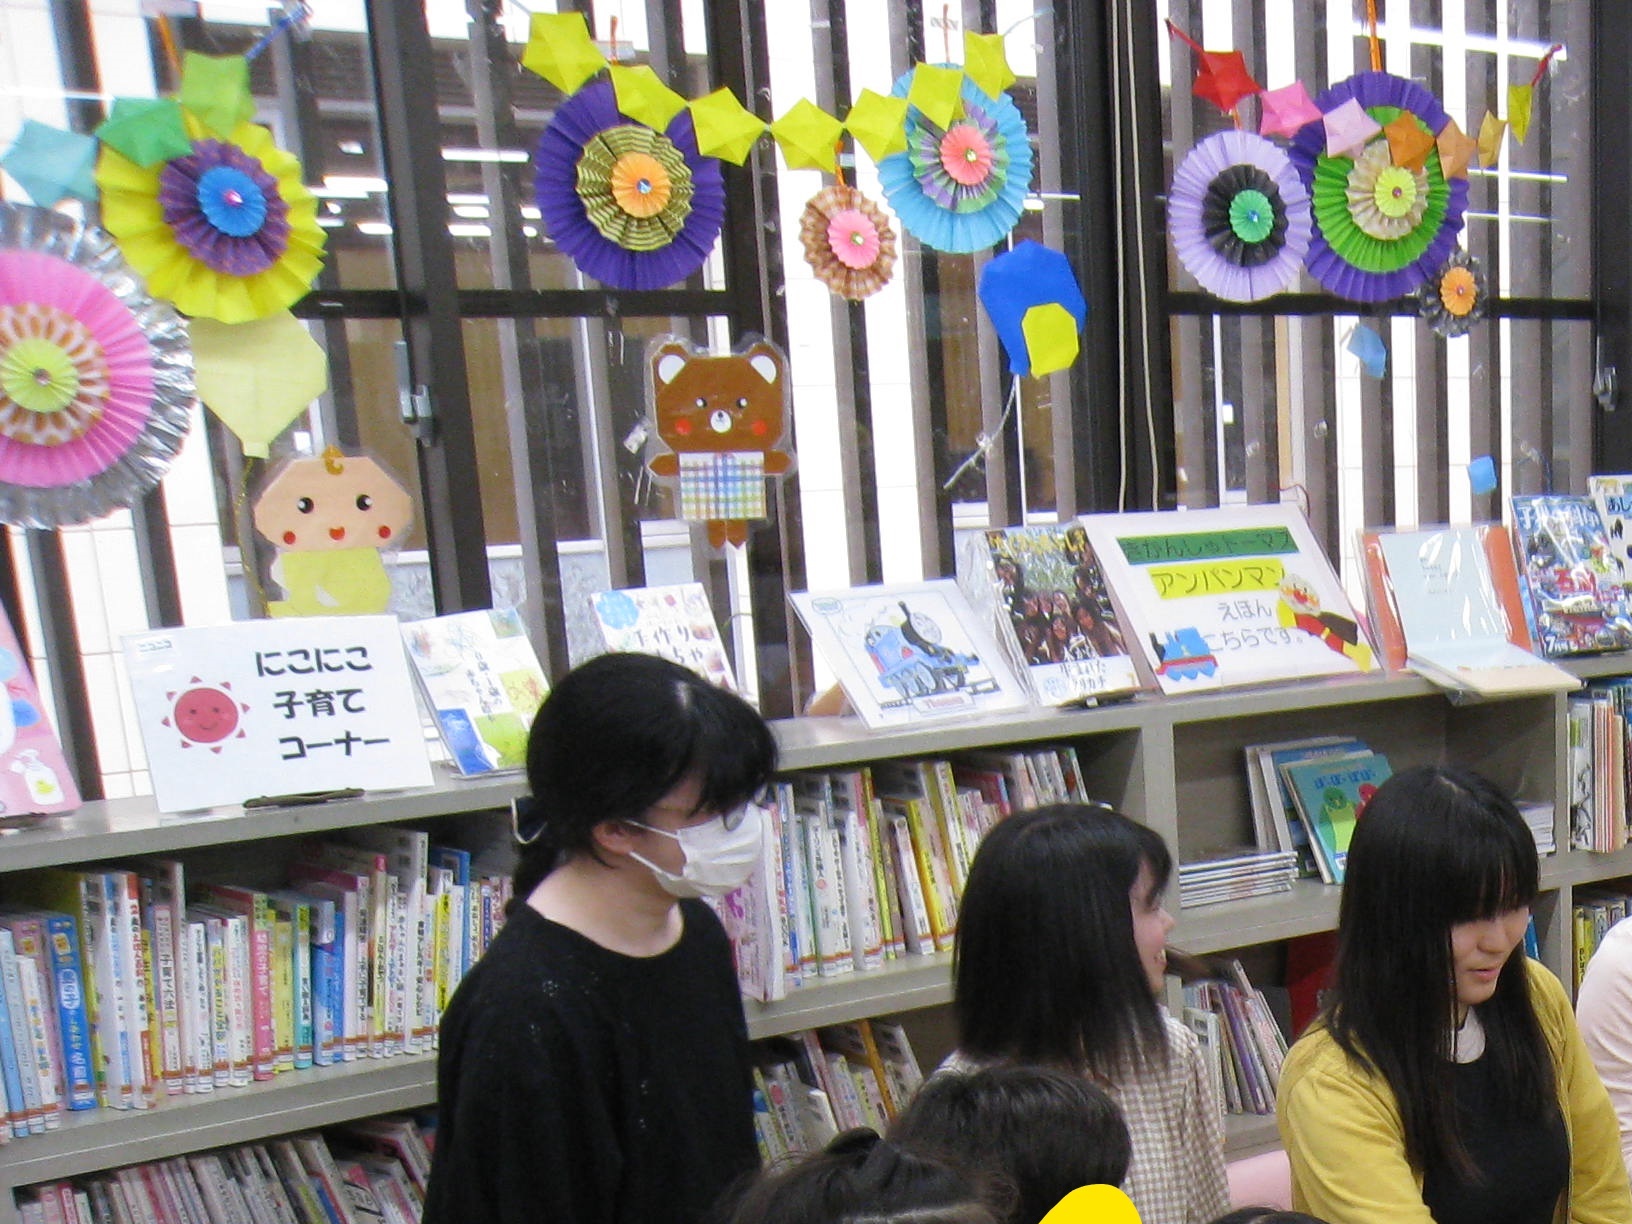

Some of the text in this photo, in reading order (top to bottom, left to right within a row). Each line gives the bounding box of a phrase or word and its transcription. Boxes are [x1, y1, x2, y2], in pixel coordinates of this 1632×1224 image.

[1151, 565, 1286, 596] アンパンマン
[1218, 598, 1273, 622] えほん
[1203, 626, 1304, 653] こちらです。
[255, 645, 373, 677] にこにこ
[273, 688, 366, 719] 子育て
[279, 730, 390, 760] コーナー
